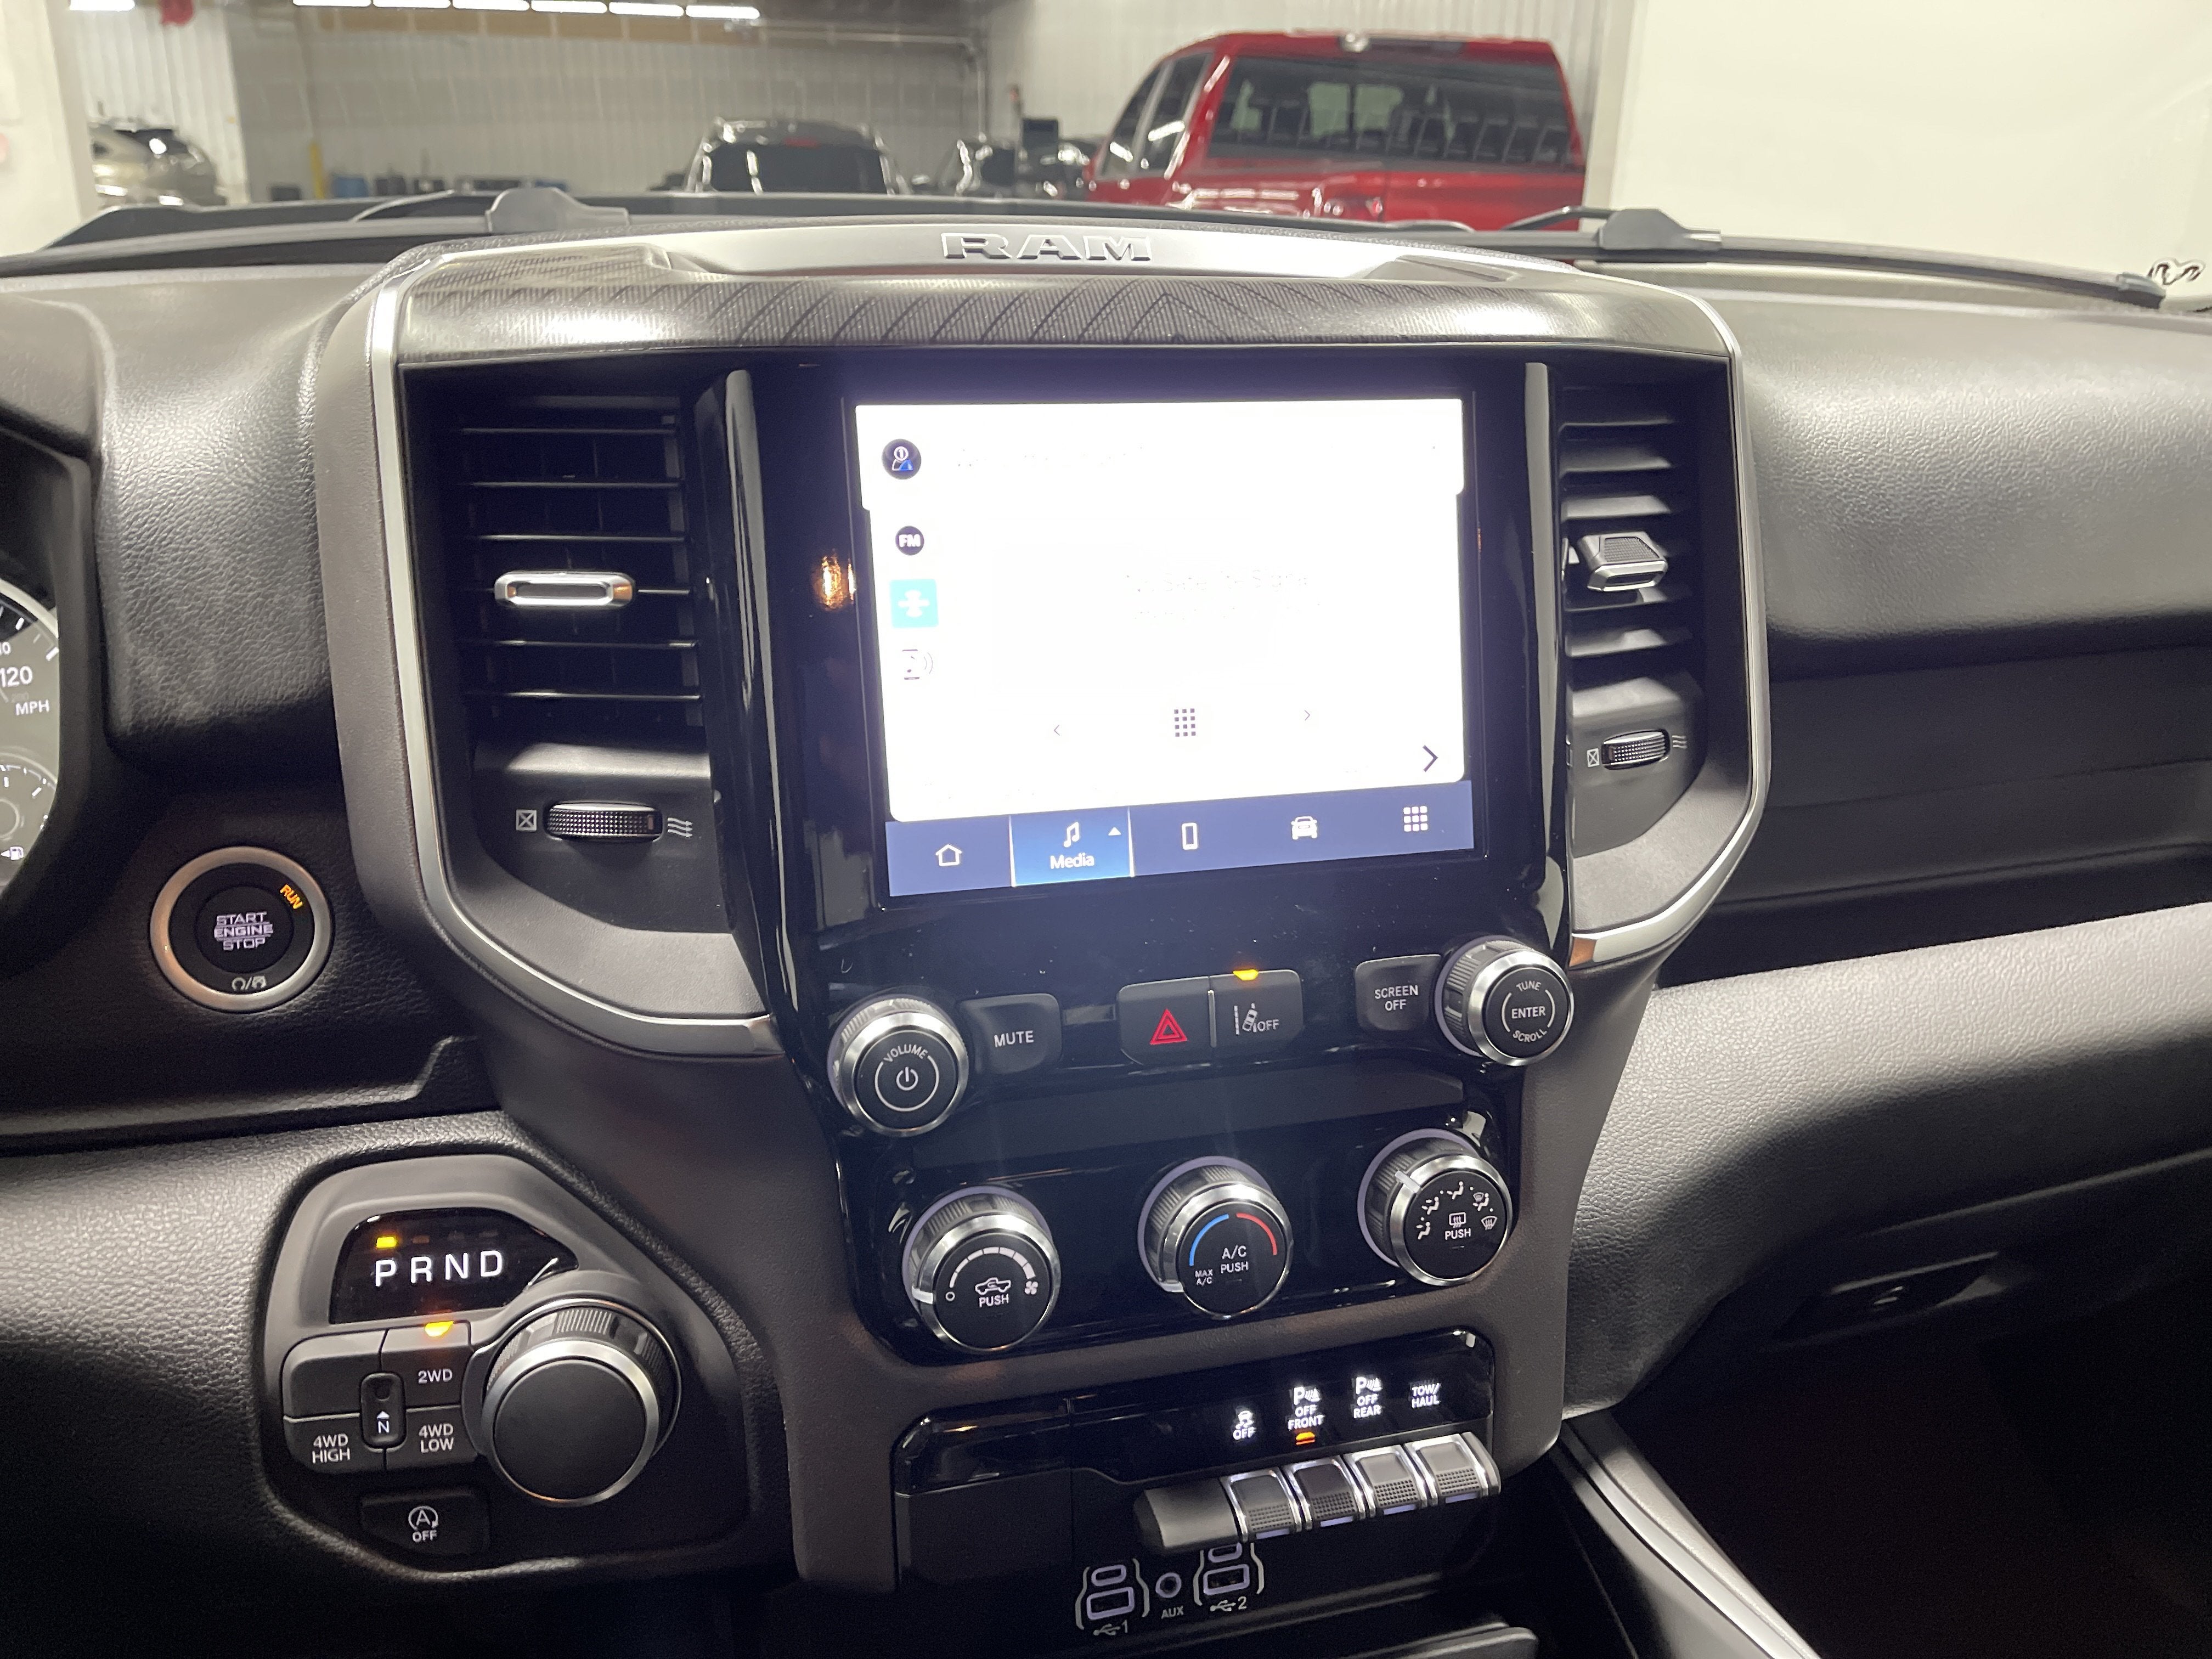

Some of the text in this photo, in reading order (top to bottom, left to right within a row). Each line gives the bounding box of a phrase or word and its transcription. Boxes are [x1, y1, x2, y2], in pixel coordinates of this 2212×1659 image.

[941, 233, 1152, 261] RAM
[899, 534, 922, 548] FM
[0, 665, 32, 688] 120
[15, 699, 50, 716] MPH
[1050, 852, 1094, 869] Media
[280, 883, 303, 910] RUN
[216, 911, 267, 926] START
[213, 924, 273, 939] ENGINE
[223, 937, 266, 951] STOP
[1375, 985, 1419, 999] SCREEN
[1516, 981, 1542, 992] TUNE
[1385, 998, 1407, 1012] OFF
[1511, 1006, 1546, 1019] ENTER
[1257, 1019, 1280, 1032] OFF
[994, 1030, 1034, 1047] MUTE
[1513, 1029, 1547, 1043] SCROLL
[883, 1044, 928, 1063] VOLUME
[1444, 1228, 1471, 1240] PUSH
[1222, 1245, 1247, 1261] A/C
[1195, 1269, 1214, 1278] MAX
[1220, 1261, 1249, 1274] PUSH
[1196, 1277, 1213, 1286] A/C
[979, 1294, 1009, 1308] PUSH
[418, 1369, 453, 1384] 2WD
[1412, 1383, 1441, 1397] TOW/
[1357, 1393, 1378, 1406] OFF
[1412, 1395, 1440, 1408] HAUL
[1295, 1404, 1316, 1417] OFF
[1353, 1405, 1382, 1418] REAR
[378, 1420, 390, 1434] N
[1288, 1414, 1324, 1431] FRONT
[419, 1423, 454, 1438] 4WD
[1233, 1427, 1255, 1440] OFF
[313, 1433, 348, 1448] 4WD
[420, 1437, 454, 1454] LOW
[312, 1447, 350, 1464] HIGH
[413, 1530, 437, 1542] OFF
[1238, 1596, 1247, 1610] 2
[1161, 1605, 1184, 1619] AUX
[1121, 1620, 1128, 1634] 1
